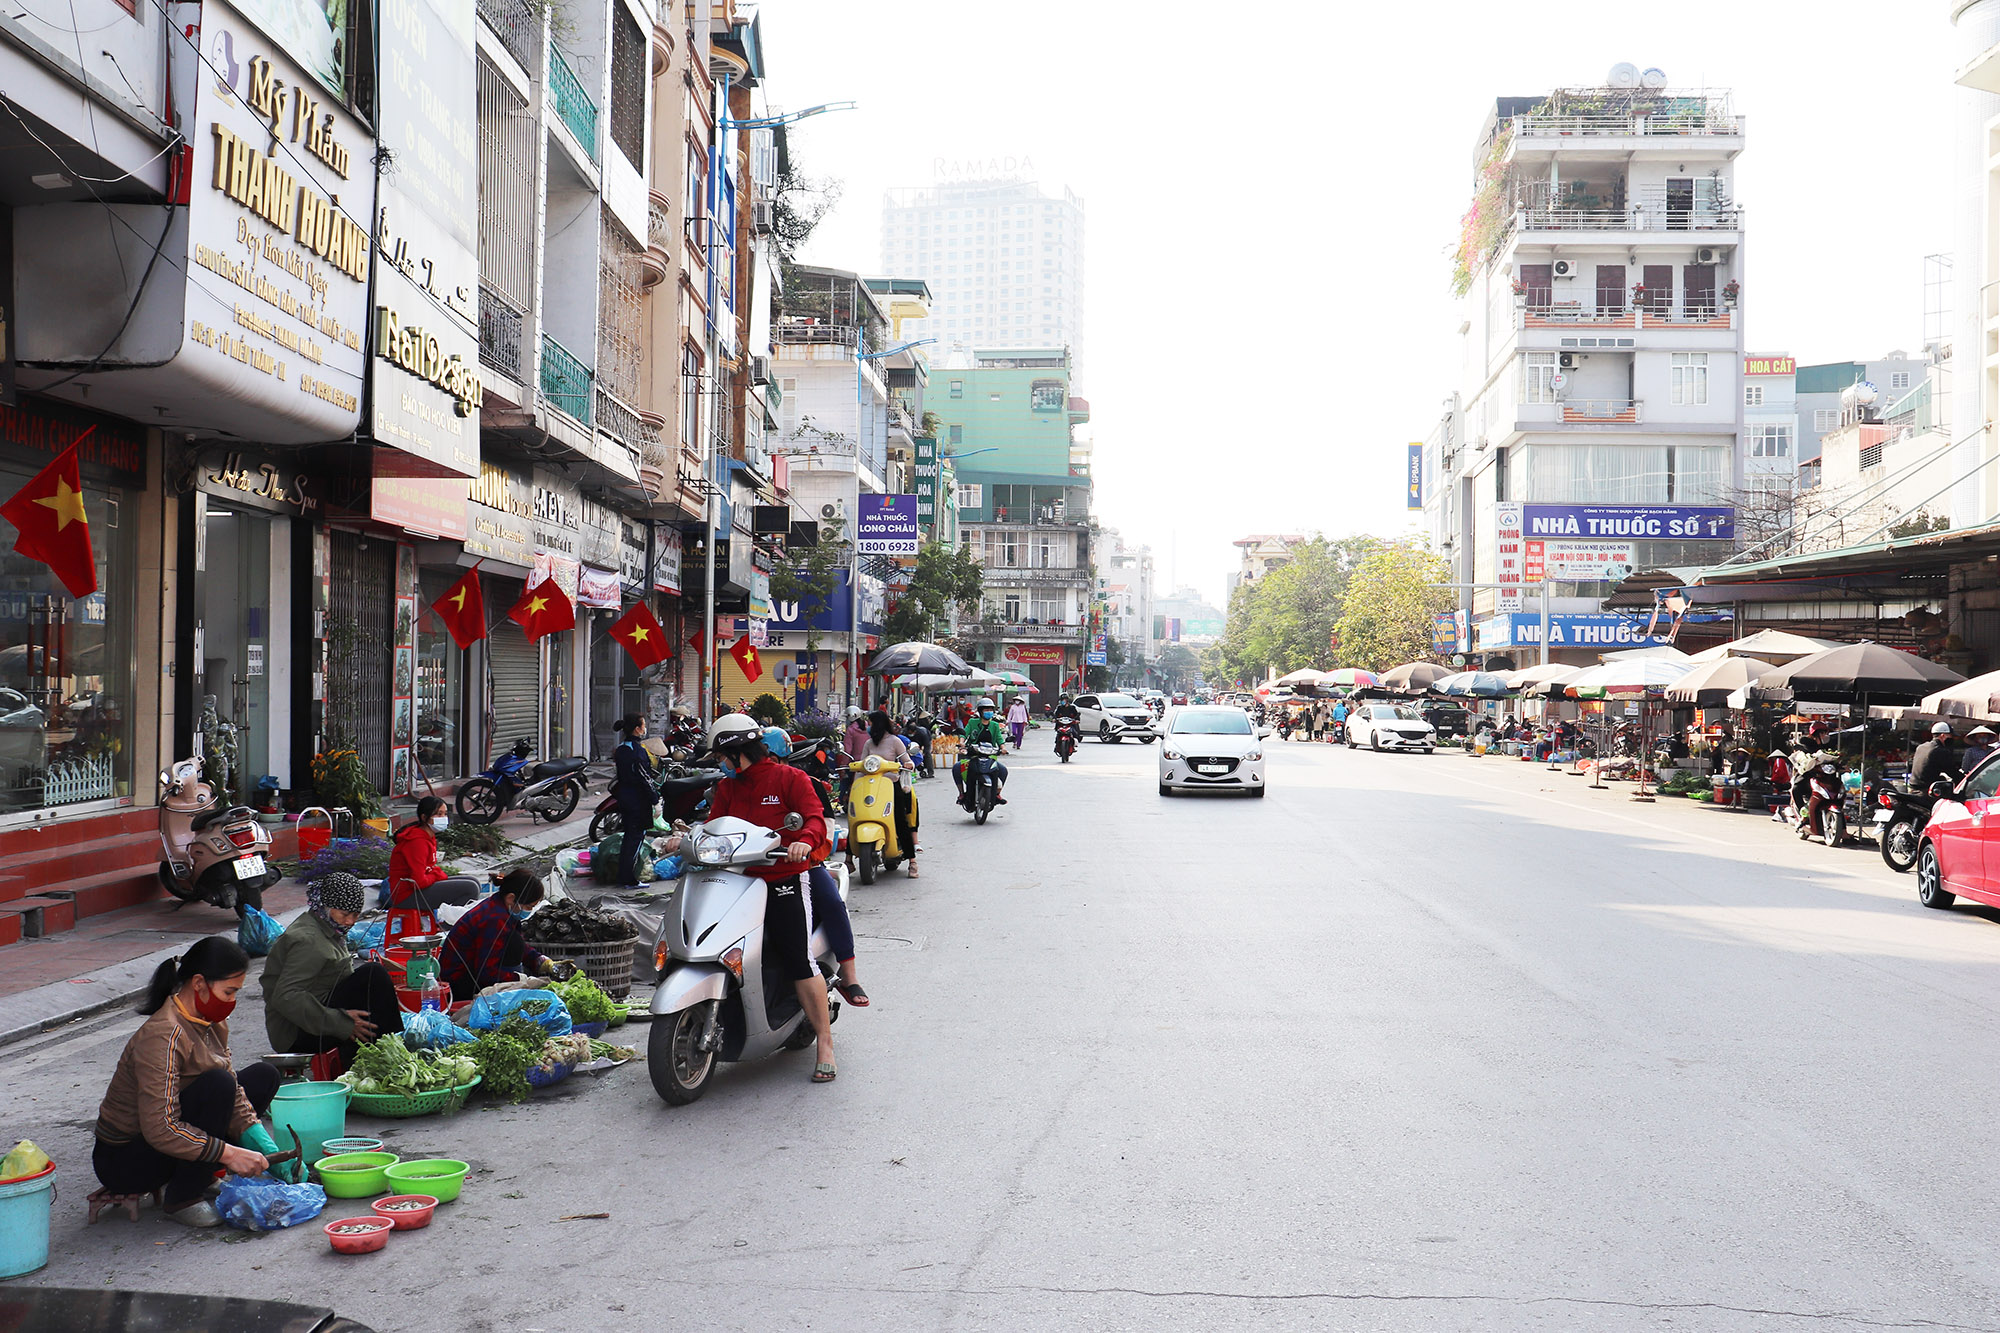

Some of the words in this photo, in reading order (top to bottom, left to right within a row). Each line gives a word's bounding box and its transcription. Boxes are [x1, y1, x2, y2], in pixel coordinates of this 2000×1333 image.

[246, 54, 289, 158] Mỹ
[291, 86, 350, 181] Phẩm
[419, 79, 451, 141] TRANG
[933, 155, 1034, 177] RAMADA
[211, 122, 297, 235] THANH
[295, 193, 369, 283] HOÀNG
[263, 233, 286, 269] Hơn
[306, 261, 329, 311] Ngày
[256, 275, 279, 307] HÀNG
[280, 289, 297, 317] HÀN
[300, 302, 317, 328] THÁI
[321, 315, 342, 343] NHẬT
[344, 328, 360, 352] NGA
[375, 306, 425, 380] Nail
[424, 330, 483, 418] Design
[1750, 360, 1771, 374] HOA
[1772, 357, 1793, 373] CÁT
[400, 390, 417, 416] ĐÀO
[918, 443, 933, 457] NHÀ
[915, 461, 936, 477] THUỐC
[1411, 454, 1420, 484] GPBANK
[286, 474, 318, 516] Spa
[917, 481, 932, 496] HÒA
[866, 513, 882, 521] NHÀ
[883, 512, 908, 521] THUỐC
[1532, 514, 1580, 534] NHÀ
[1586, 514, 1661, 536] THUỐC
[1668, 514, 1701, 536] SỐ
[859, 524, 887, 533] LONG
[887, 523, 916, 533] CHÂU
[1498, 528, 1520, 539] PHÒNG
[690, 545, 725, 556] HON
[859, 542, 886, 551] 1800
[888, 542, 916, 552] 6928
[1499, 542, 1519, 553] KHÁM
[1503, 559, 1515, 568] NHI
[1498, 570, 1520, 583] QUẢNG
[1501, 588, 1518, 597] NINH
[1571, 620, 1648, 643] THUỐC
